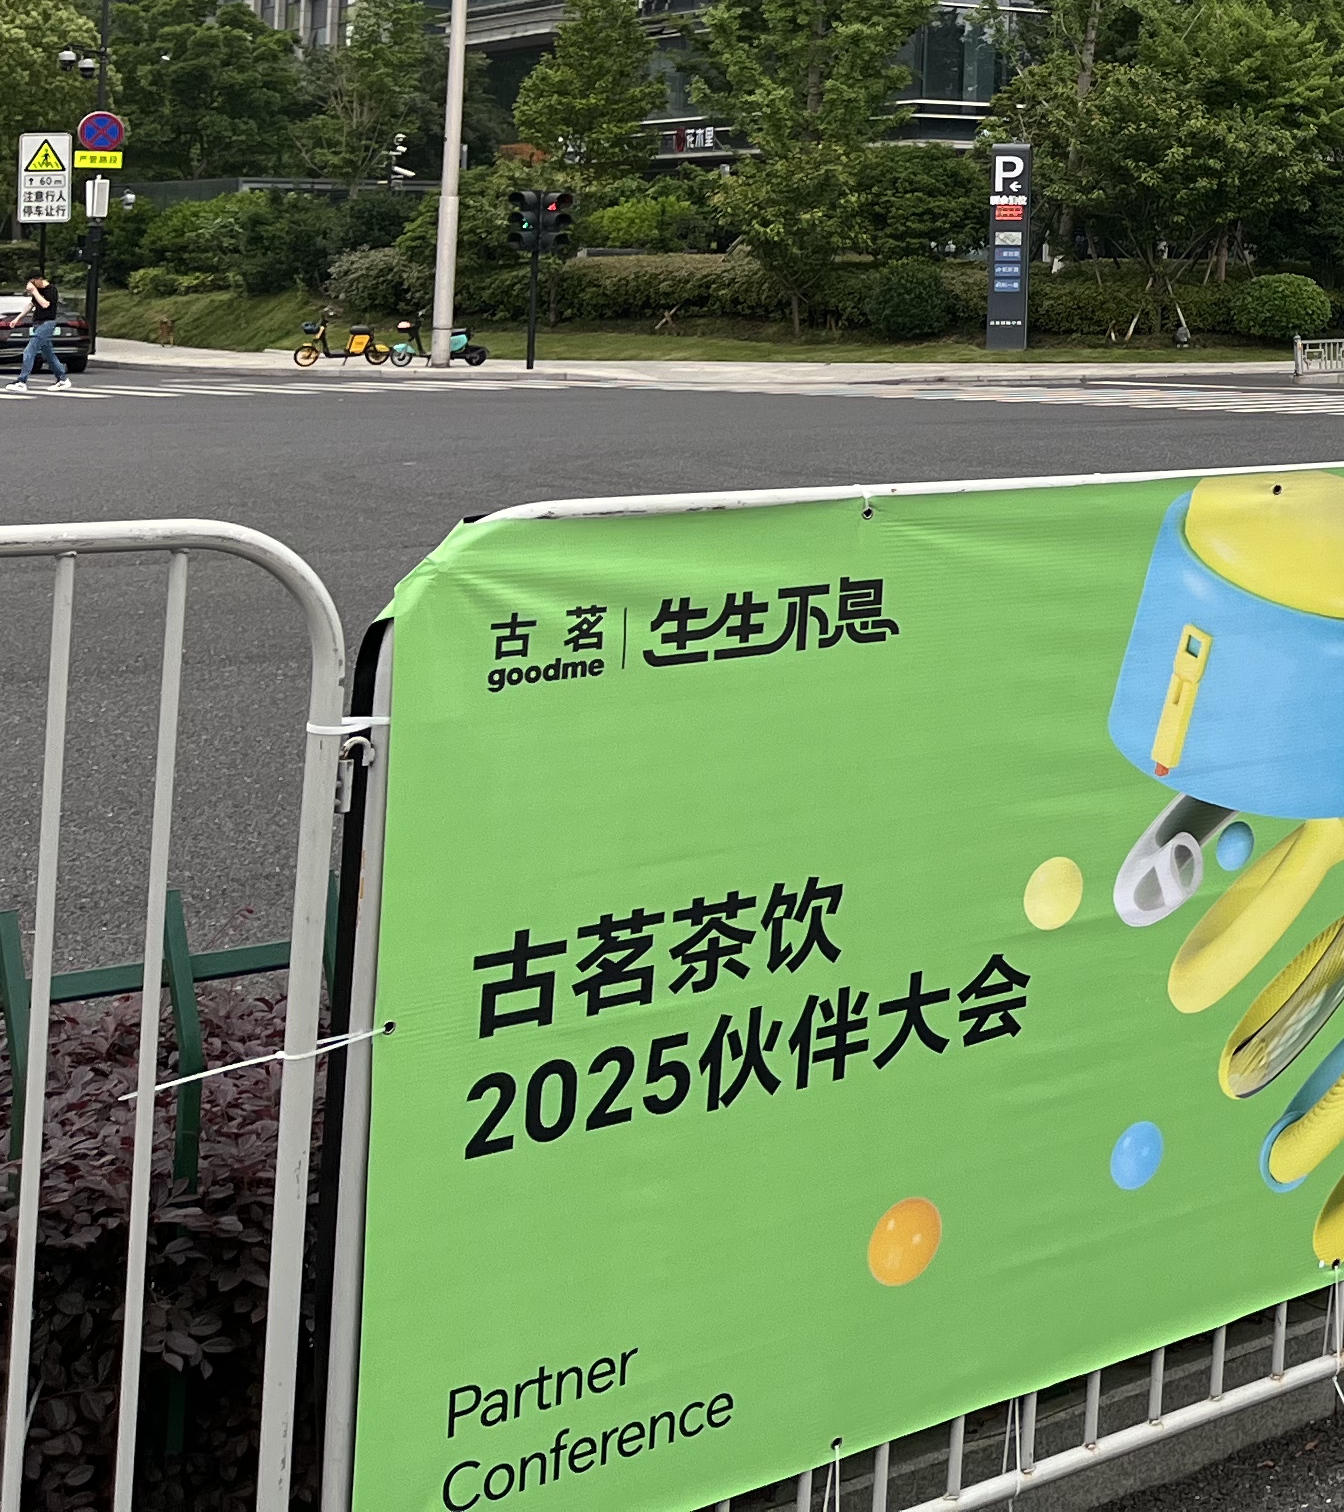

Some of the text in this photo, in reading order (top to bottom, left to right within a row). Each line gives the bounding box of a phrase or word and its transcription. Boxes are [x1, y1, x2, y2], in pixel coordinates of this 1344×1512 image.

[23, 189, 66, 202] 注意行人
[23, 205, 66, 217] 停车让行
[994, 155, 1024, 192] P
[490, 576, 900, 668] 古茗 生生不息
[487, 657, 605, 693] goodme
[472, 875, 844, 1040] 古茗茶饮
[464, 953, 1032, 1161] 2025伙伴大会
[447, 1347, 639, 1439] Partner
[442, 1392, 734, 1512] Conference
